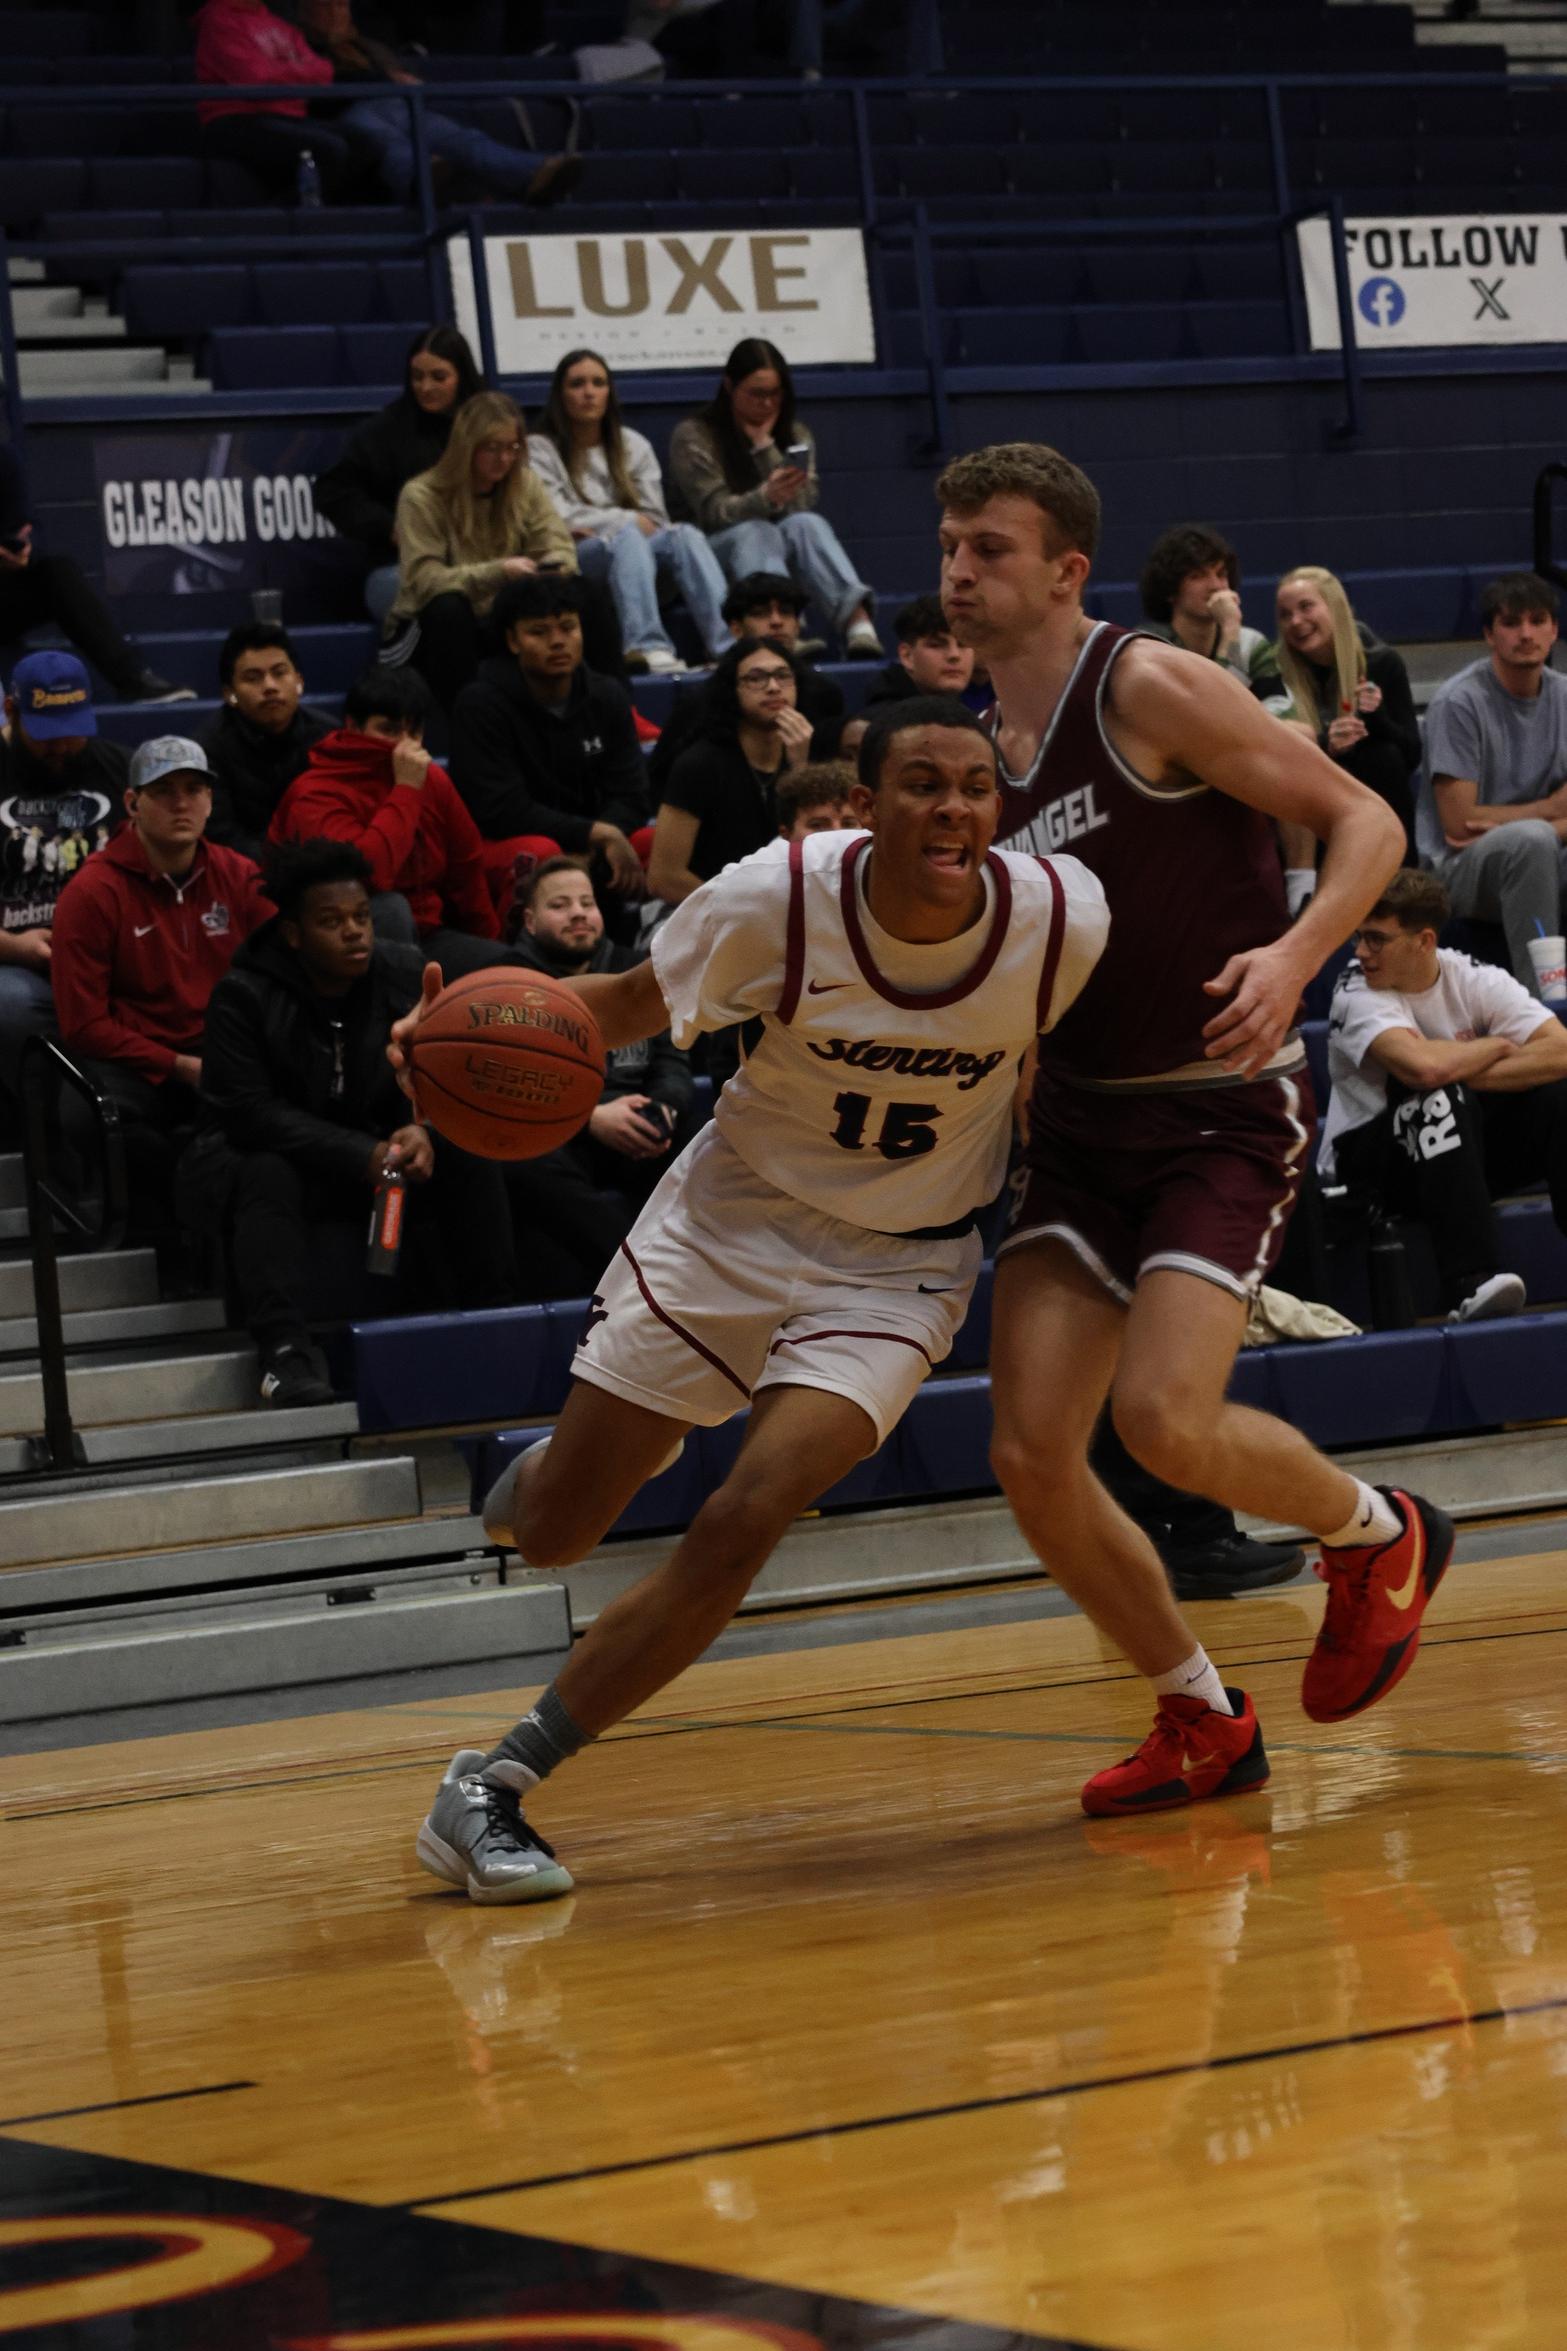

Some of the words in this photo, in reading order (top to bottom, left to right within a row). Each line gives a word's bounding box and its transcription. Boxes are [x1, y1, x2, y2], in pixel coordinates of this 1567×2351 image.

[505, 235, 819, 318] LUXE
[103, 478, 247, 548] GLEASON
[995, 781, 1111, 857] ANGEL
[468, 1002, 590, 1055] SPALDING
[465, 1053, 574, 1092] LEGACY
[829, 1091, 945, 1160] 15
